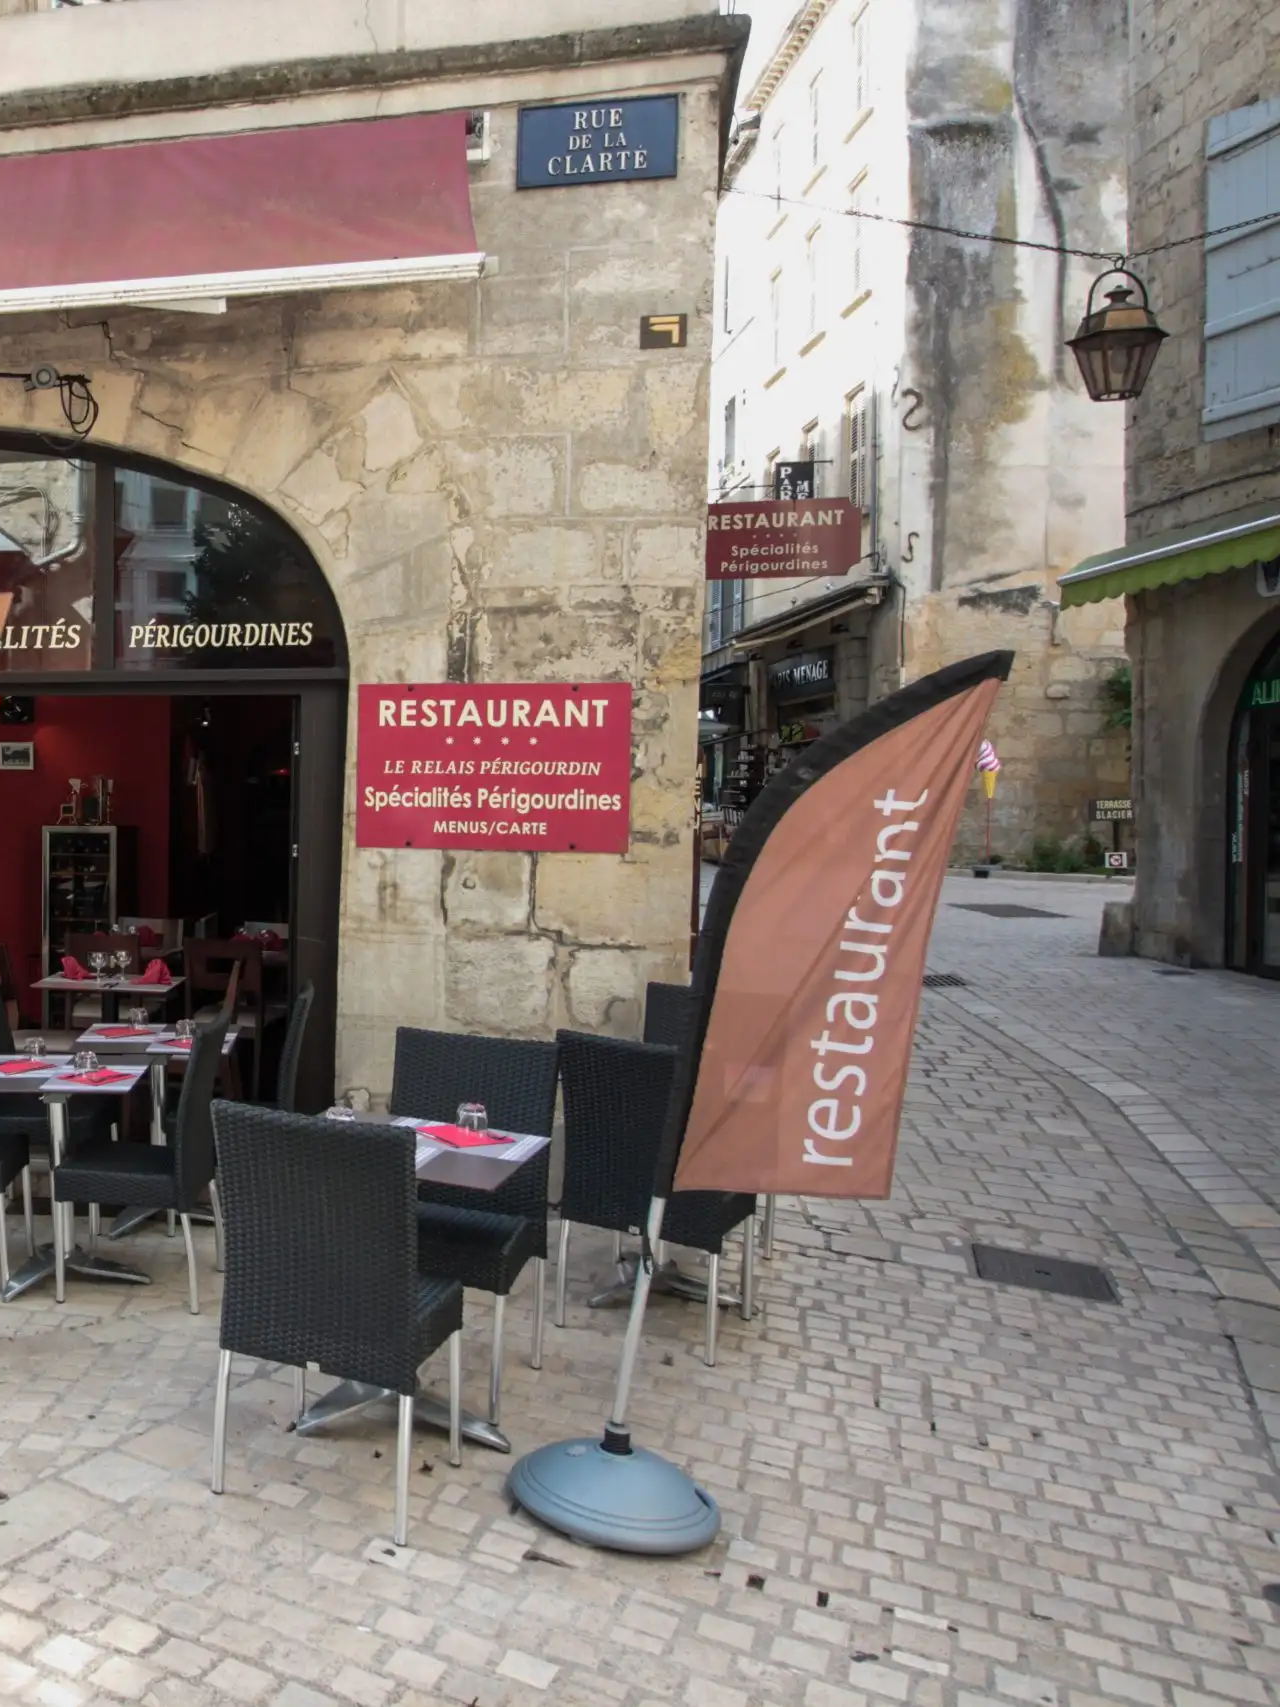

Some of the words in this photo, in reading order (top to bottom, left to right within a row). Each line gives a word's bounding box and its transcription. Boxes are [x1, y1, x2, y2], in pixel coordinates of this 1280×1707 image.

[573, 107, 624, 130] RUE
[568, 134, 593, 151] DE
[603, 132, 628, 148] LA
[547, 145, 648, 176] CLARTÉ
[707, 509, 845, 531] RESTAURANT
[731, 541, 819, 559] Spécialités
[720, 558, 829, 574] Périgourdines
[128, 618, 313, 649] PÉRIGOURDINES
[793, 659, 829, 685] MENAGE
[378, 698, 610, 728] RESTAURANT
[383, 760, 405, 774] LE
[410, 760, 475, 775] RELAIS
[479, 757, 602, 776] PÉRIGOURDIN
[364, 785, 472, 812] Spécialités
[477, 785, 622, 814] Périgourdines
[1095, 799, 1133, 809] TERRASSE
[1095, 809, 1133, 819] GLACIER
[433, 820, 548, 836] MENUS/CARTE
[801, 788, 930, 1168] restaurant
